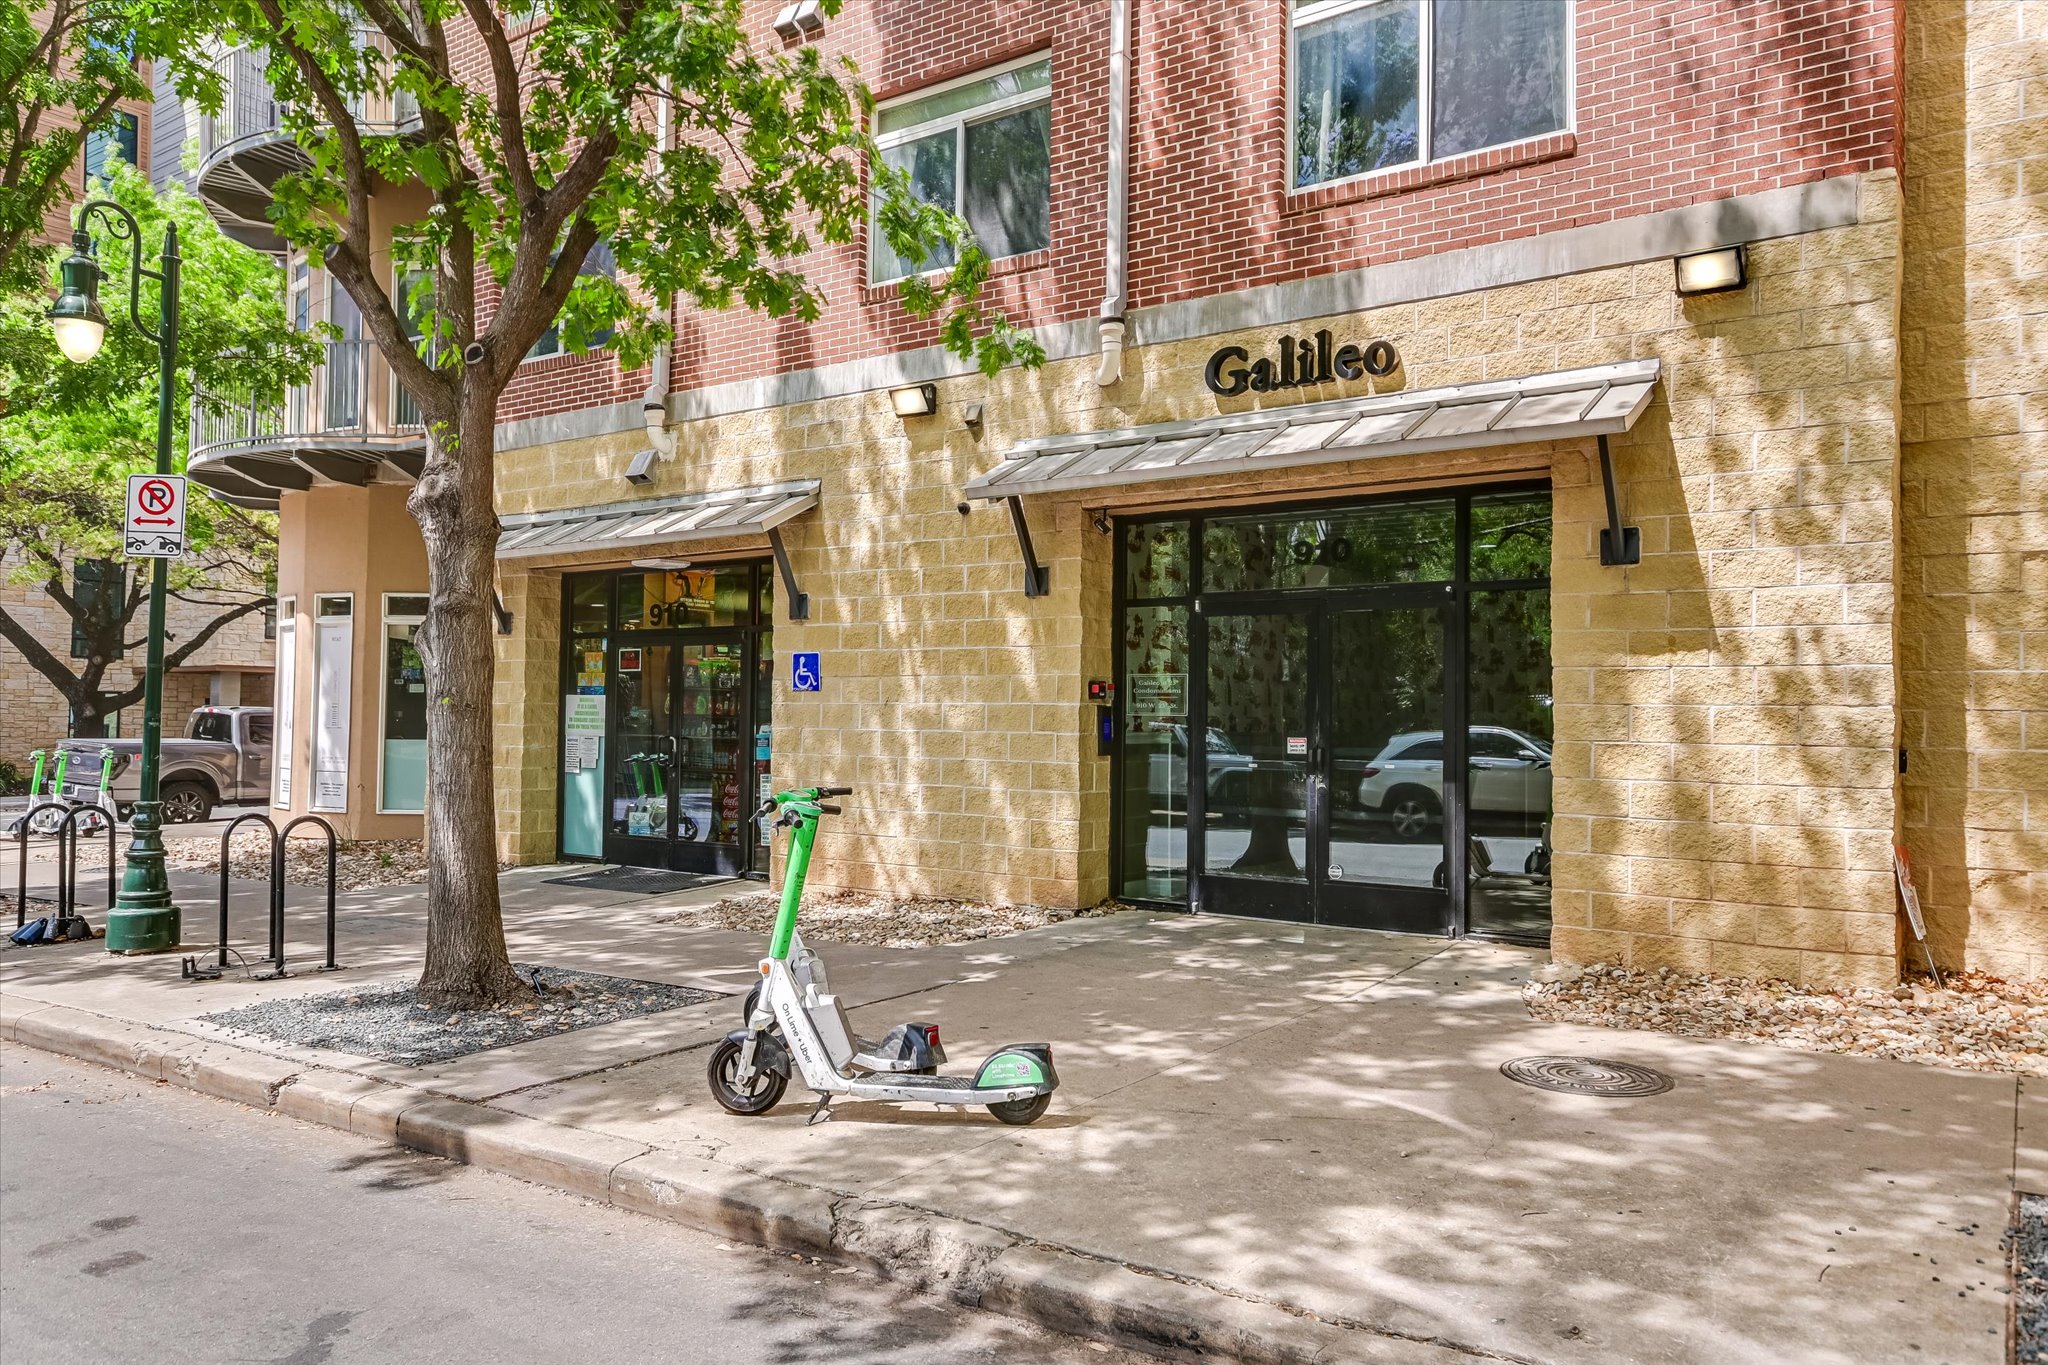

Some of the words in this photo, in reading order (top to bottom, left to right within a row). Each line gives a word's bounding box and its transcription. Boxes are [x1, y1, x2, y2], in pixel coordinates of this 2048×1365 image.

[1205, 329, 1400, 396] Galileo
[149, 487, 167, 508] P
[649, 602, 689, 627] 910
[782, 1003, 791, 1017] On
[787, 1016, 800, 1037] Lime
[800, 1043, 813, 1064] Uber
